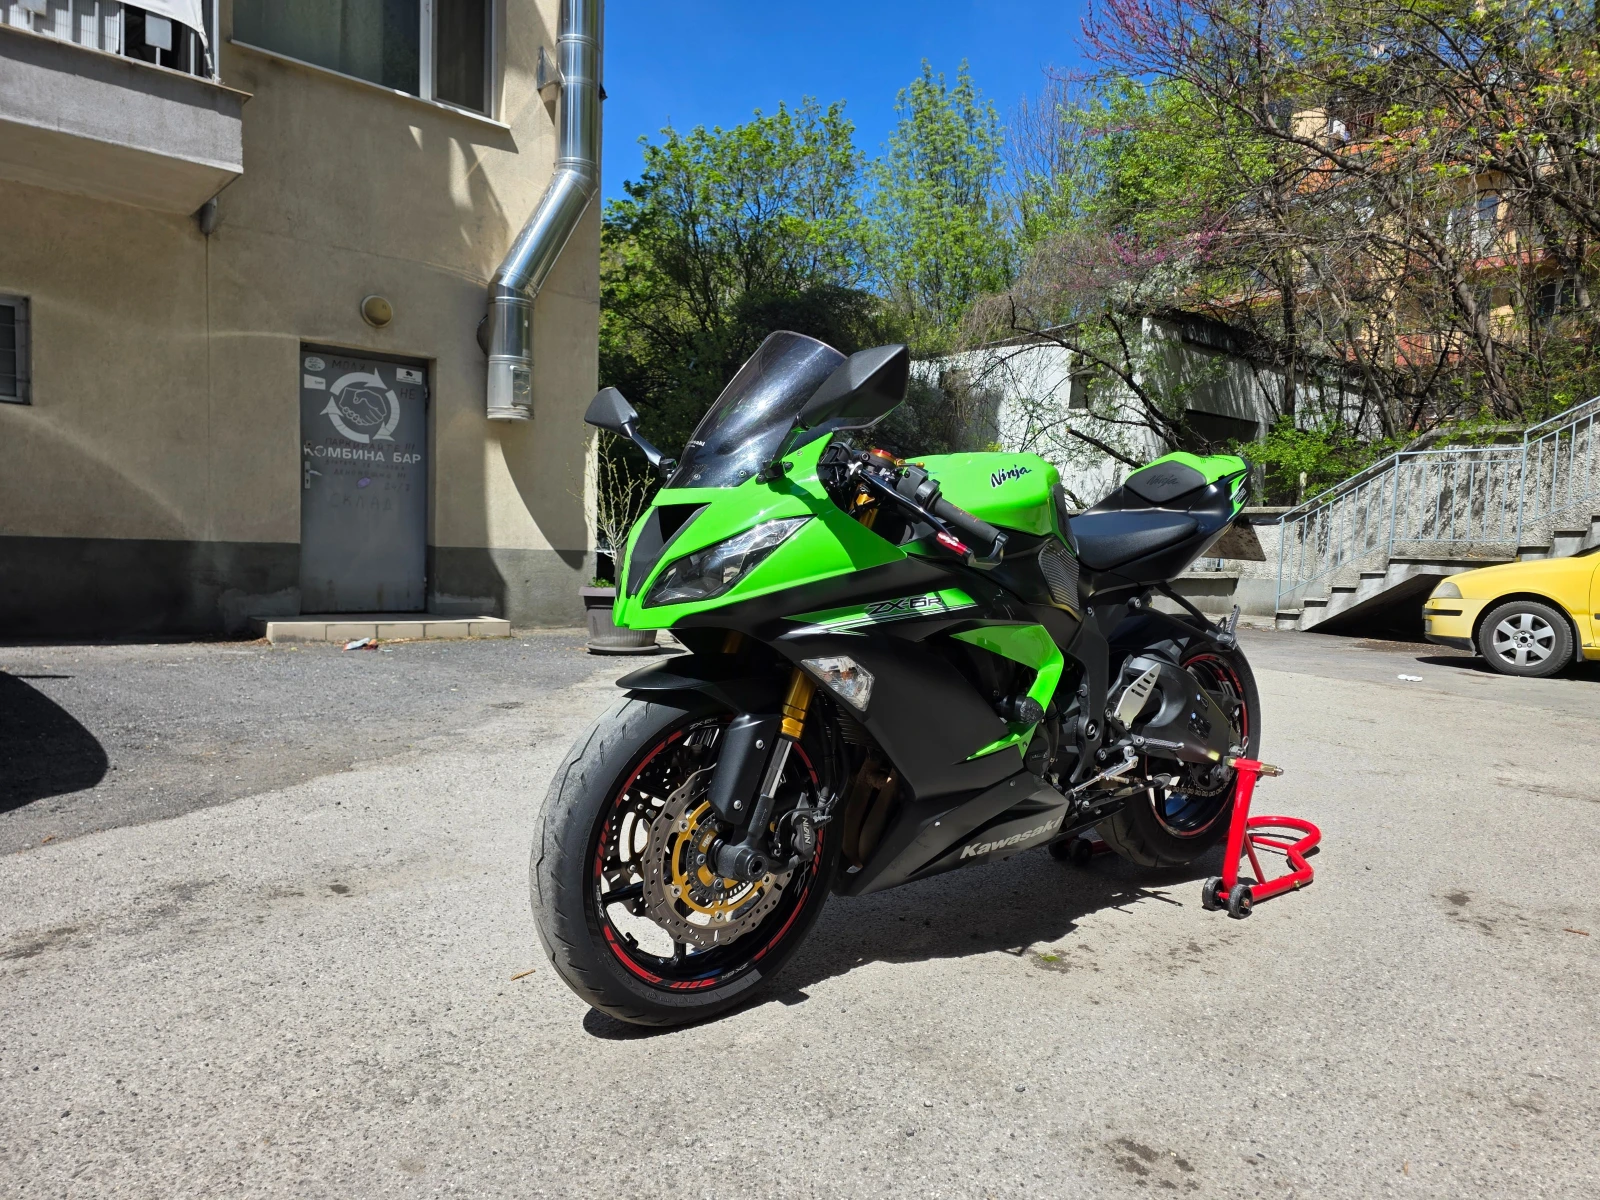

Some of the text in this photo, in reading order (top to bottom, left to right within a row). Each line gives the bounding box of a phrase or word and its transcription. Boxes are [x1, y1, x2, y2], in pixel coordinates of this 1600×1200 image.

[400, 388, 417, 400] НЕ
[304, 444, 421, 465] КОМБИНА БАР
[990, 466, 1032, 489] Ninja
[1146, 474, 1179, 489] Ninja
[864, 597, 943, 616] ZX-6R
[959, 816, 1064, 859] Kawasaki
